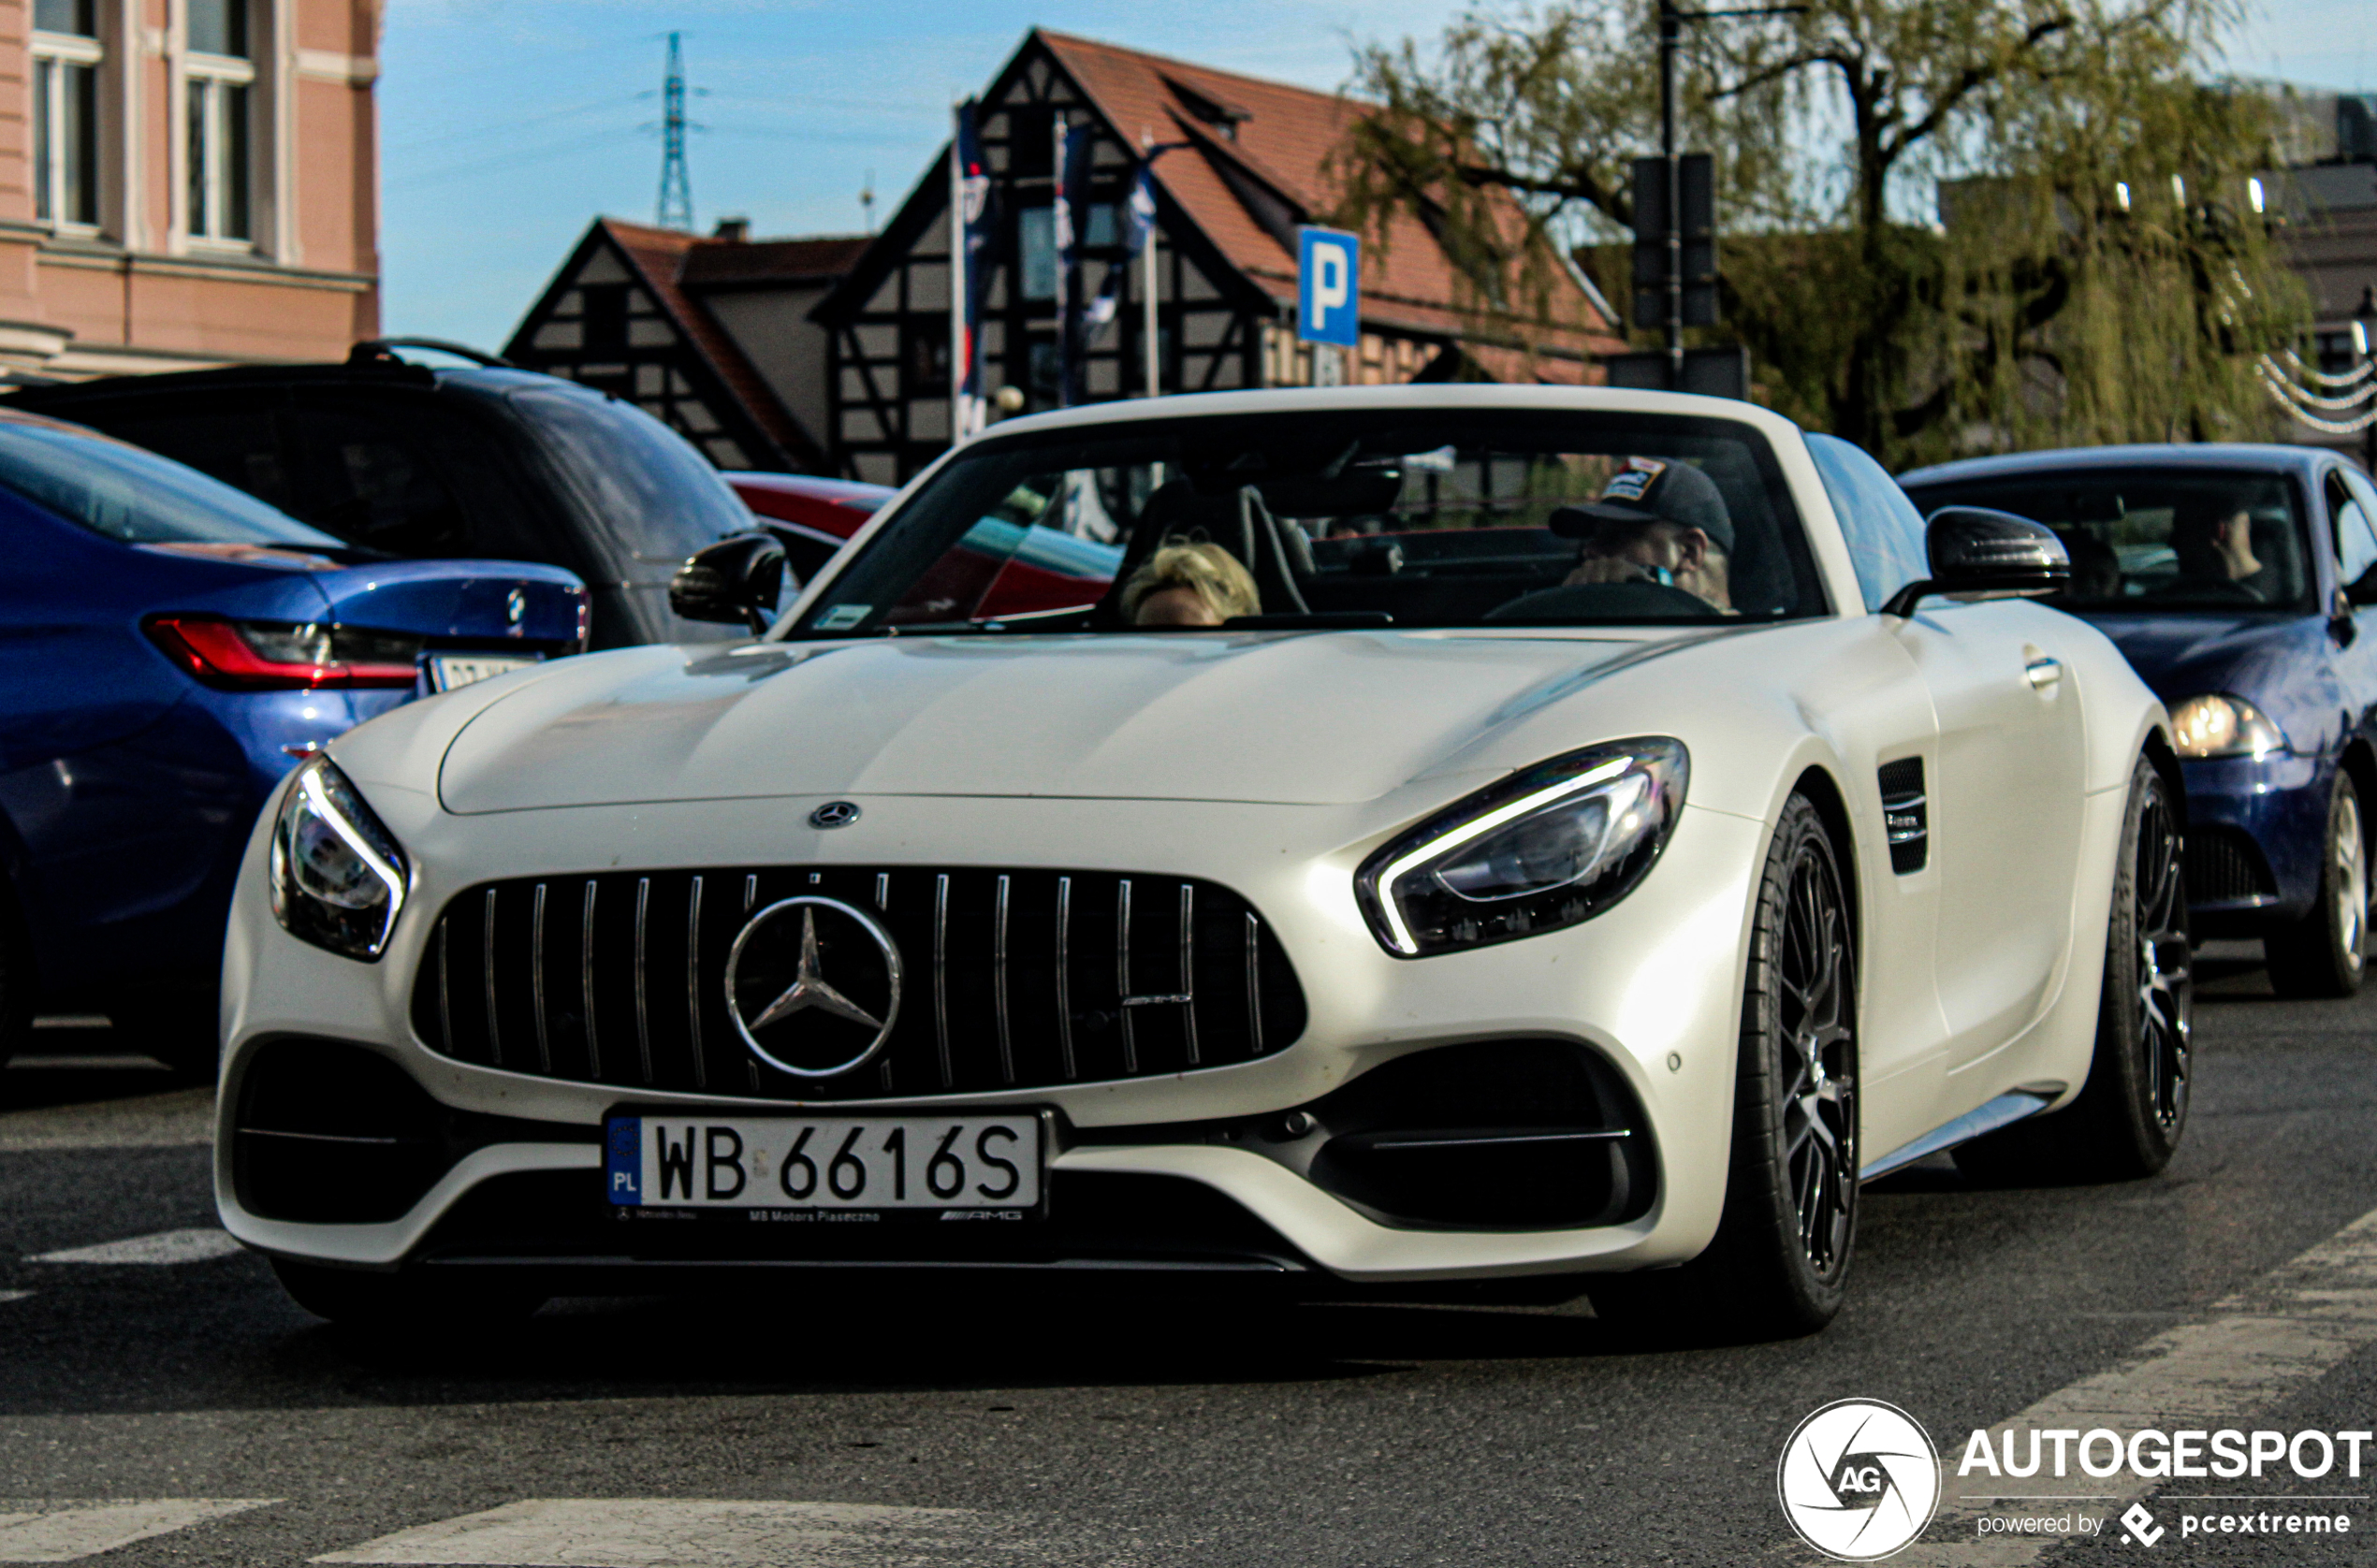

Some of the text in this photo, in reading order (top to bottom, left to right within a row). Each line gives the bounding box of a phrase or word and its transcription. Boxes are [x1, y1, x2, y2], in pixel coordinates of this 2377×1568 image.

[1312, 241, 1349, 330] P
[613, 1172, 638, 1192] PL
[656, 1125, 1020, 1201] WB 6616S
[771, 1210, 815, 1222] Motors
[816, 1210, 881, 1223] Piaseczno
